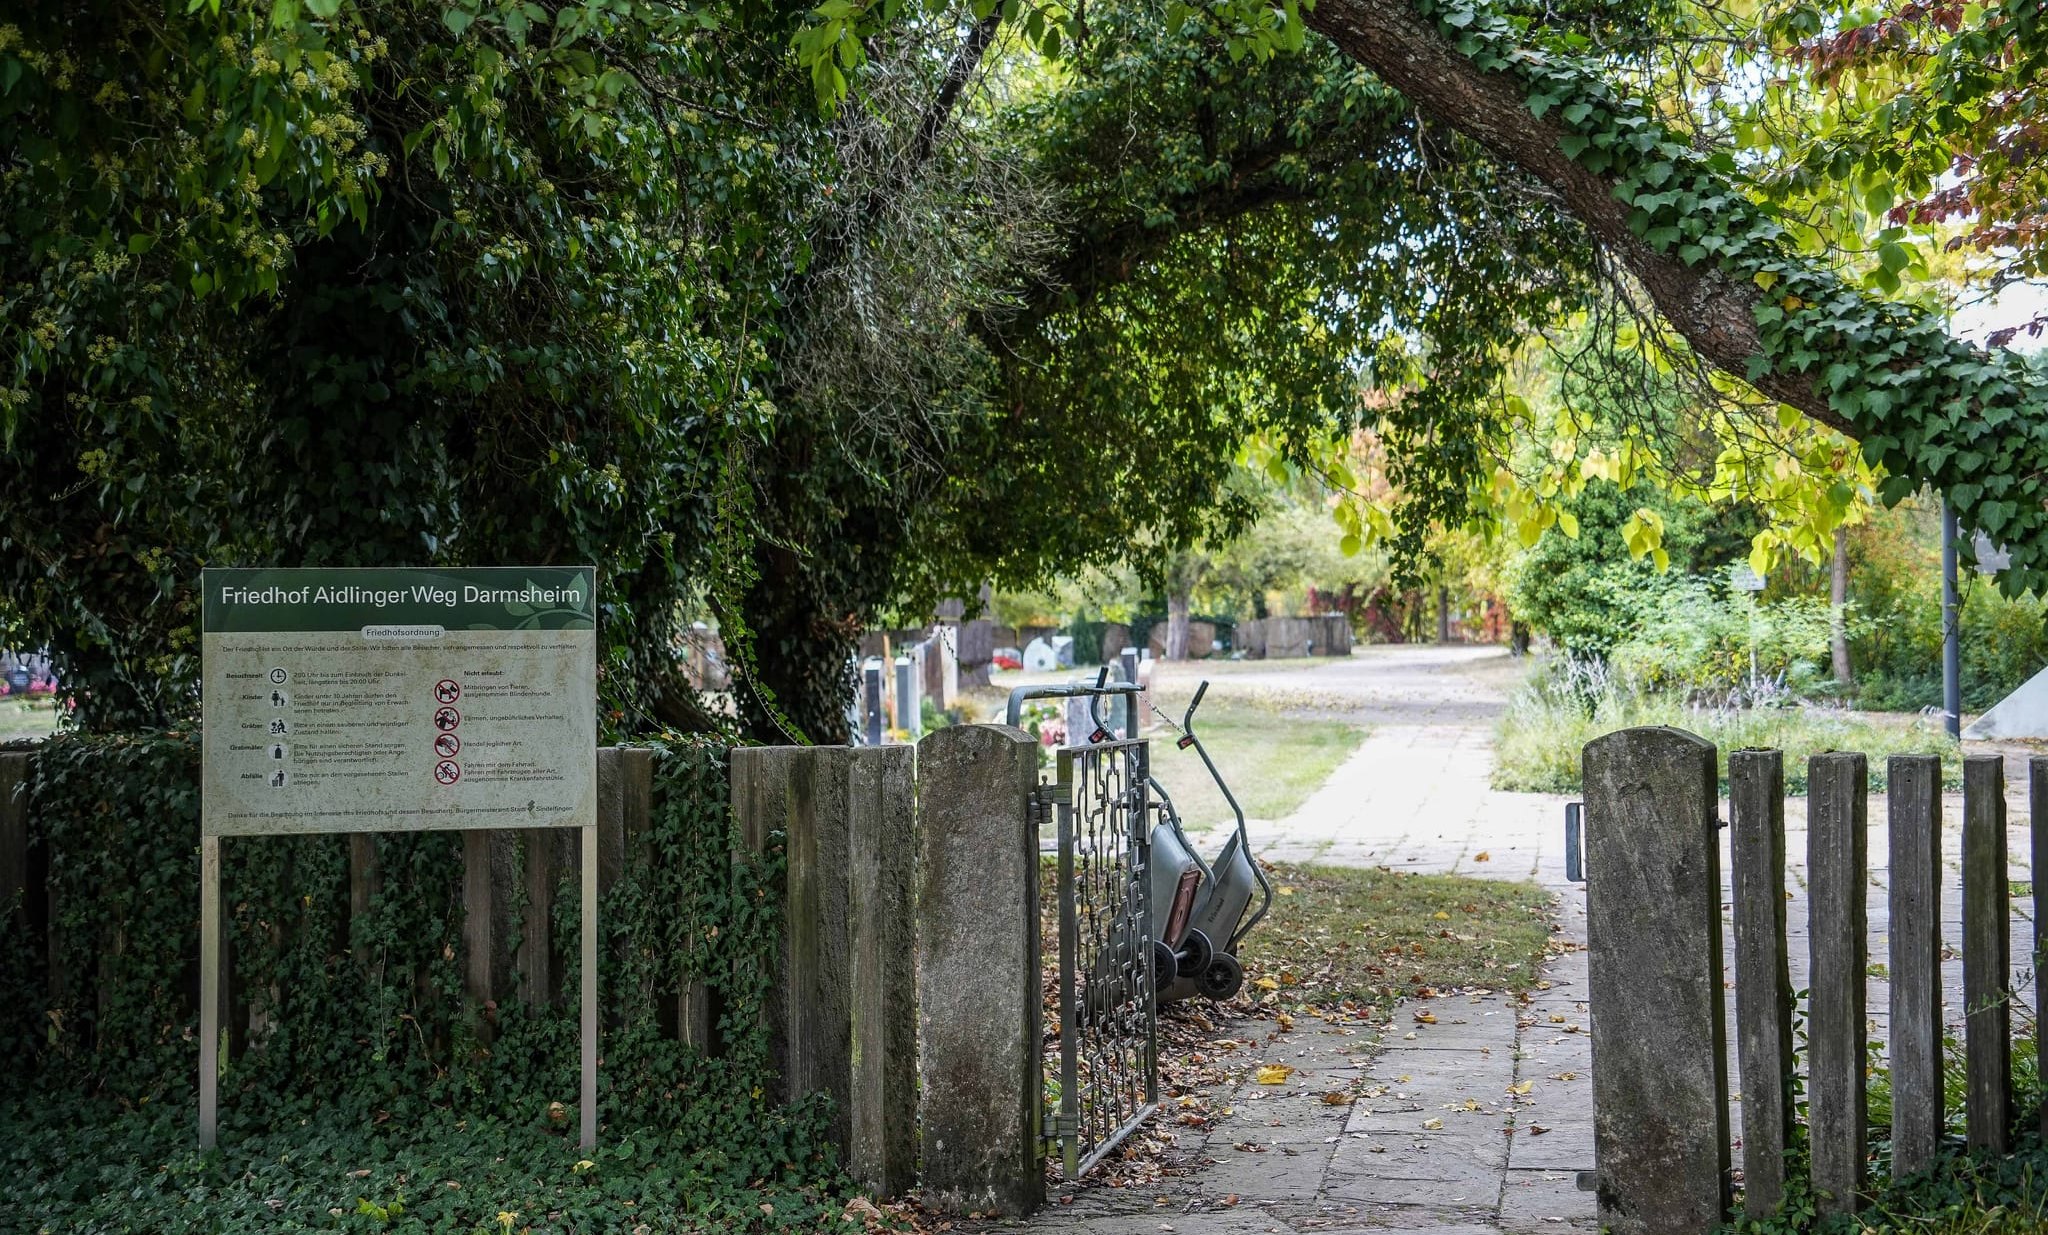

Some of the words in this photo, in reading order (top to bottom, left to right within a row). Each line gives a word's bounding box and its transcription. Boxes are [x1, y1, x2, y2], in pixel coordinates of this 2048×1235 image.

[222, 586, 310, 604] Friedhof
[313, 586, 409, 608] Aidlinger
[411, 585, 457, 607] Weg
[464, 585, 580, 603] Darmsheim
[366, 628, 440, 637] Friedhofsordnung
[535, 805, 574, 813] Sindelfingen
